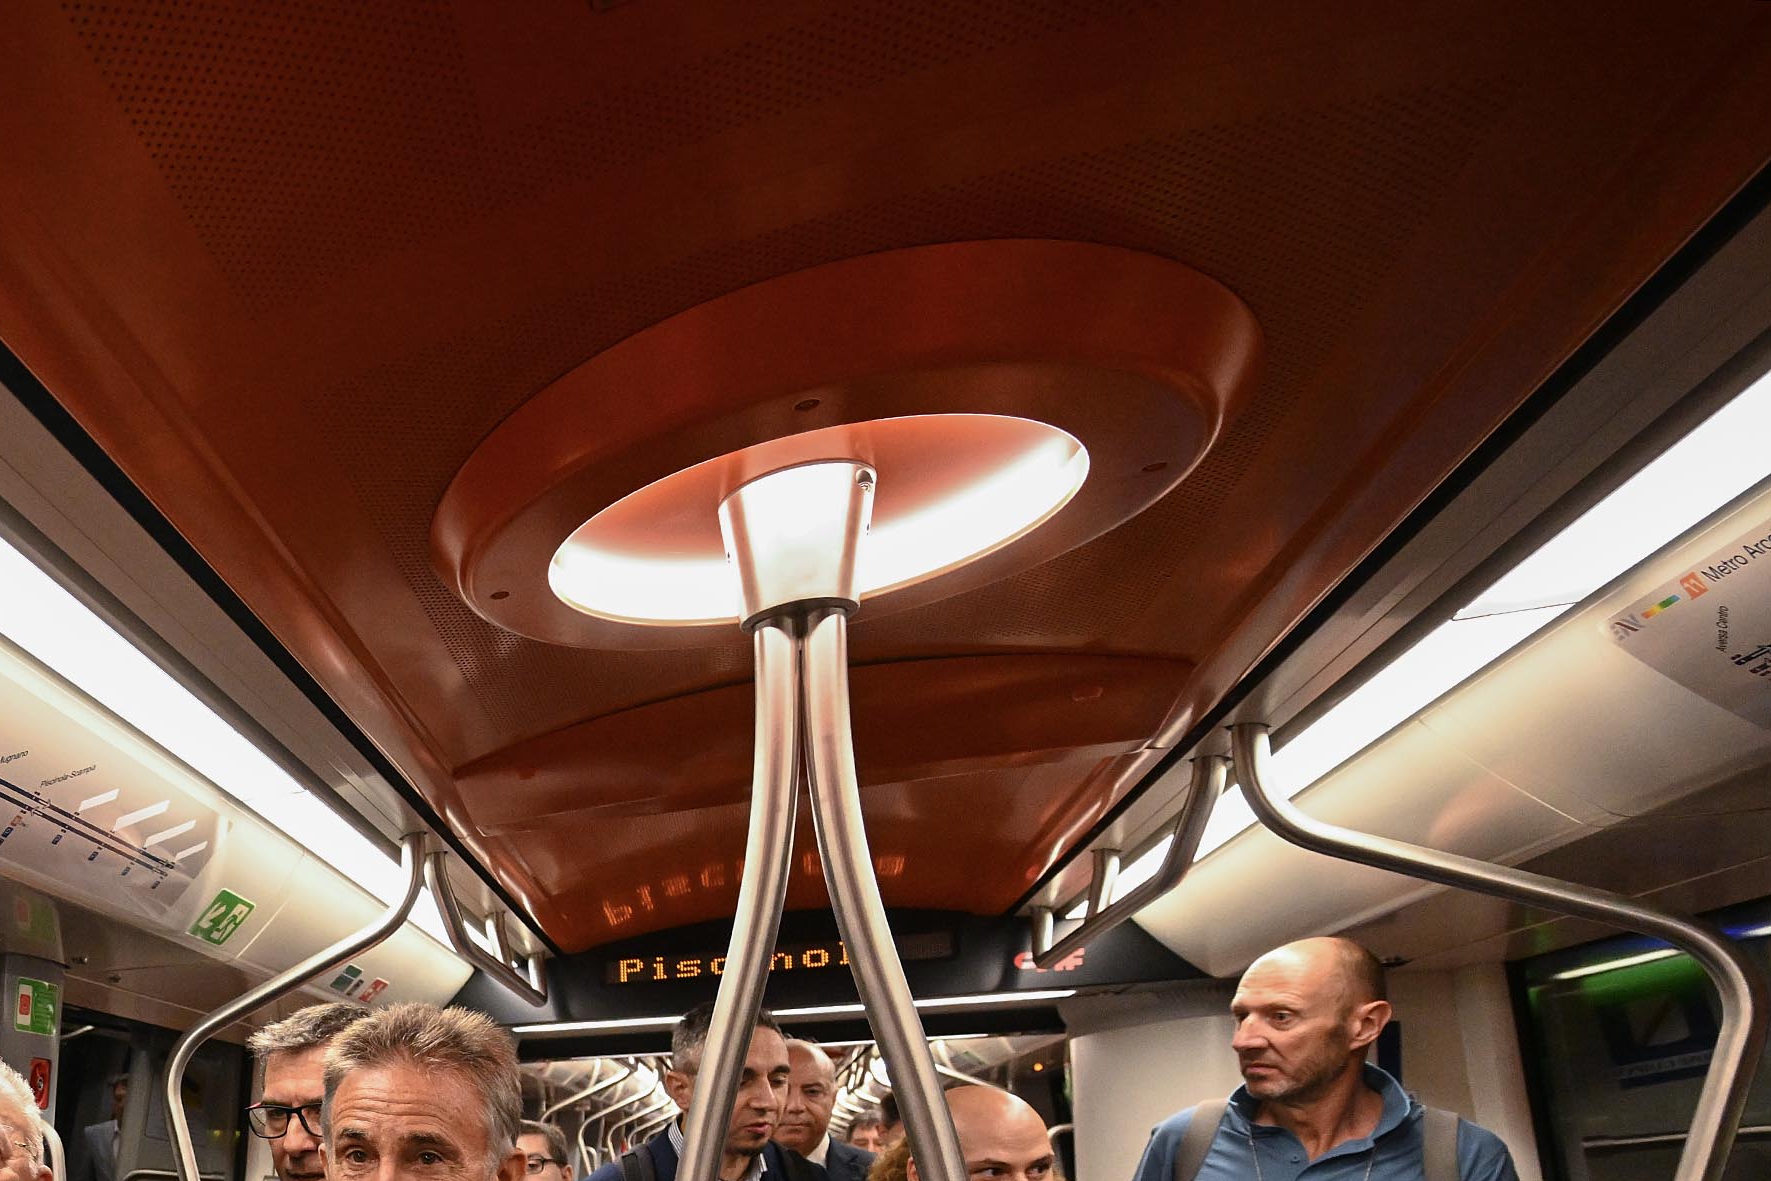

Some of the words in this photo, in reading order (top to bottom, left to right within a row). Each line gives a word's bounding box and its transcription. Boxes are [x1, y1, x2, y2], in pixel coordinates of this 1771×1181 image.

[1701, 554, 1748, 582] Metro
[1716, 606, 1729, 629] Centro
[619, 940, 850, 983] Piscnol
